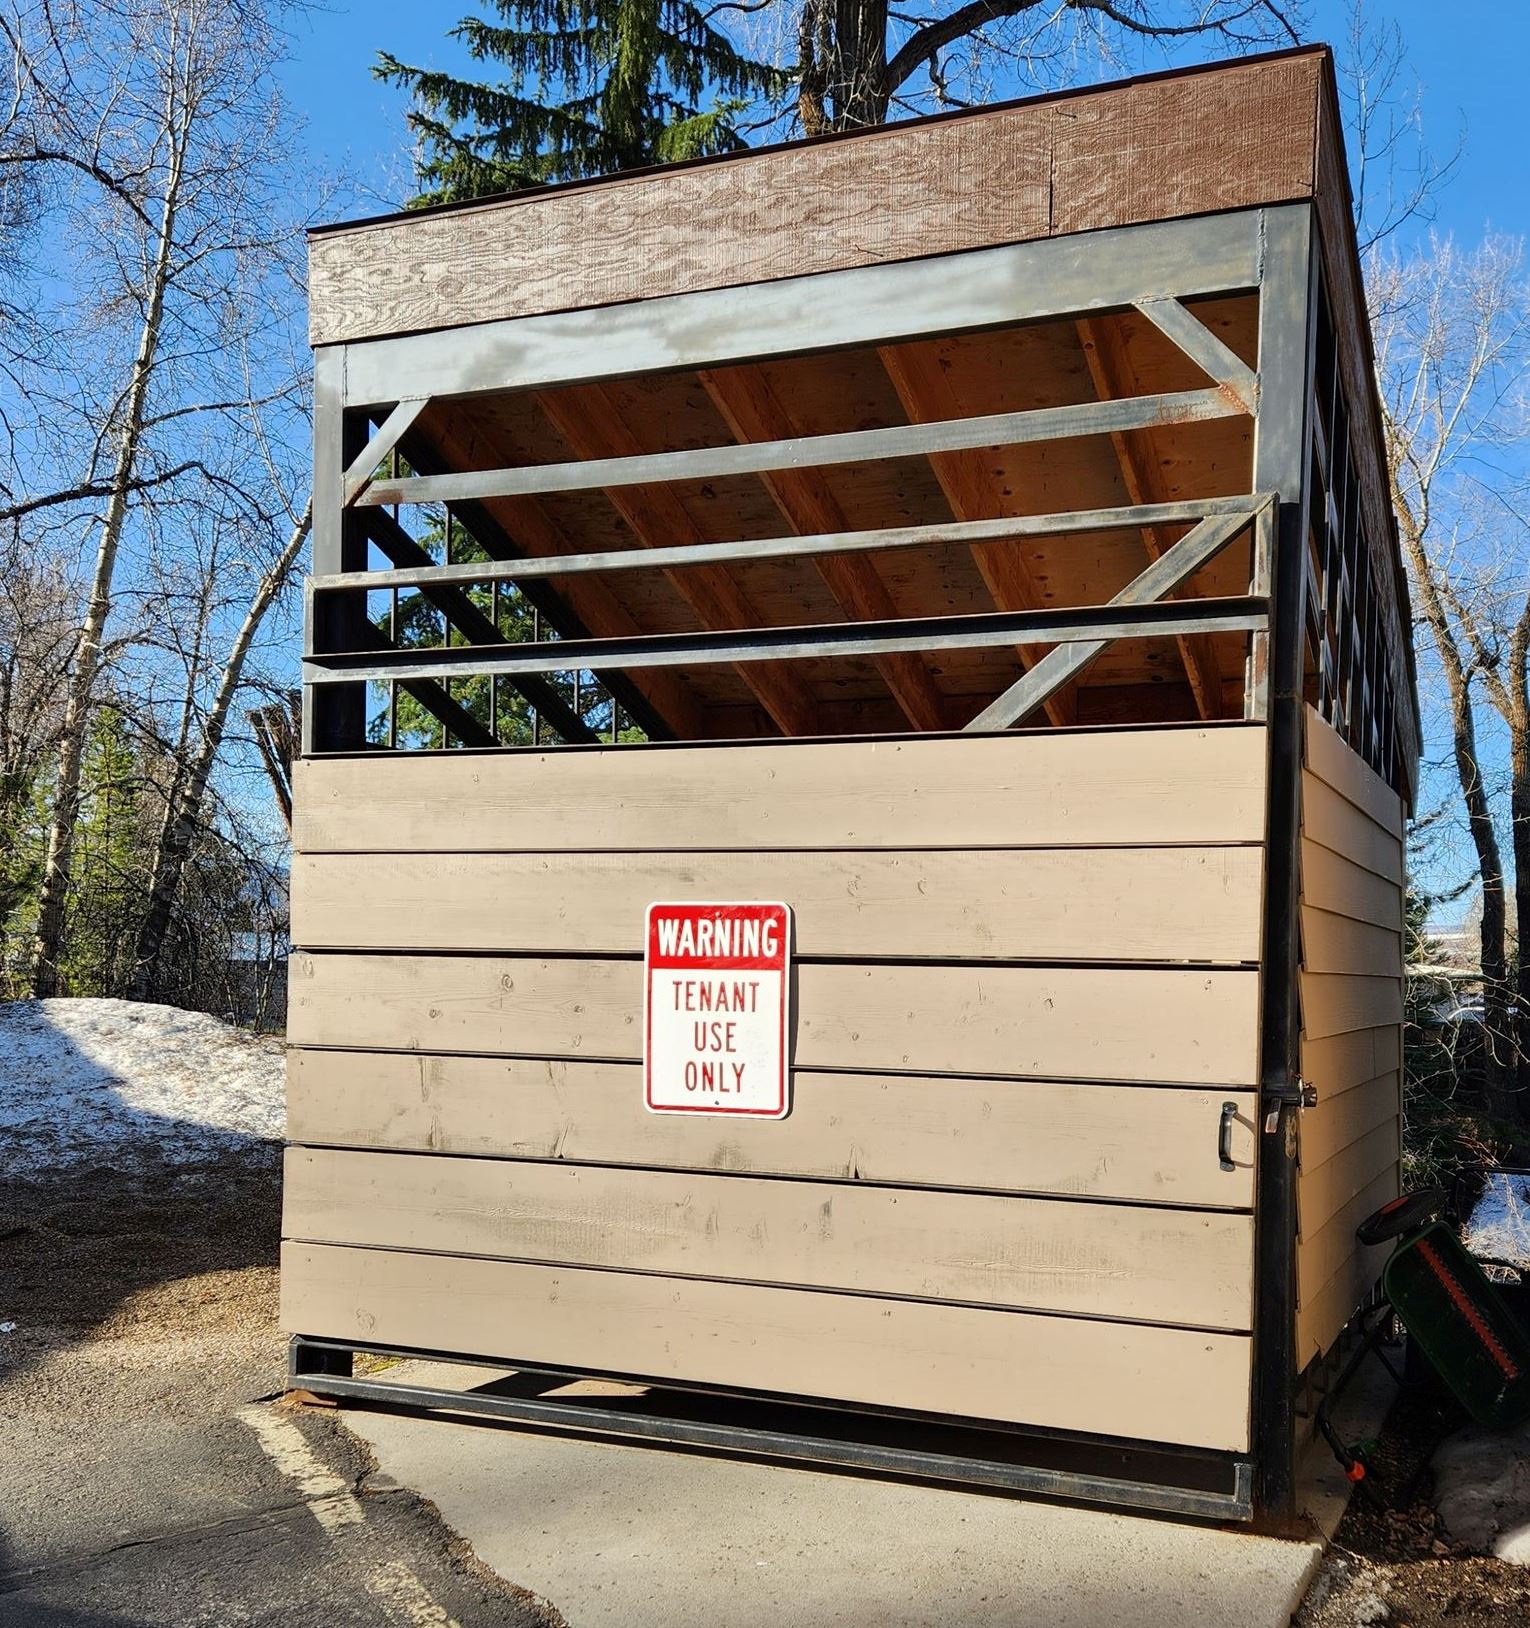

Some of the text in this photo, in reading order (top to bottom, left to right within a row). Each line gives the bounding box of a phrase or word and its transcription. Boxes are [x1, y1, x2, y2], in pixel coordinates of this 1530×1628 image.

[658, 918, 778, 957] WARNING
[672, 980, 760, 1013] TENANT
[694, 1021, 737, 1053] USE
[685, 1061, 746, 1093] ONLY
